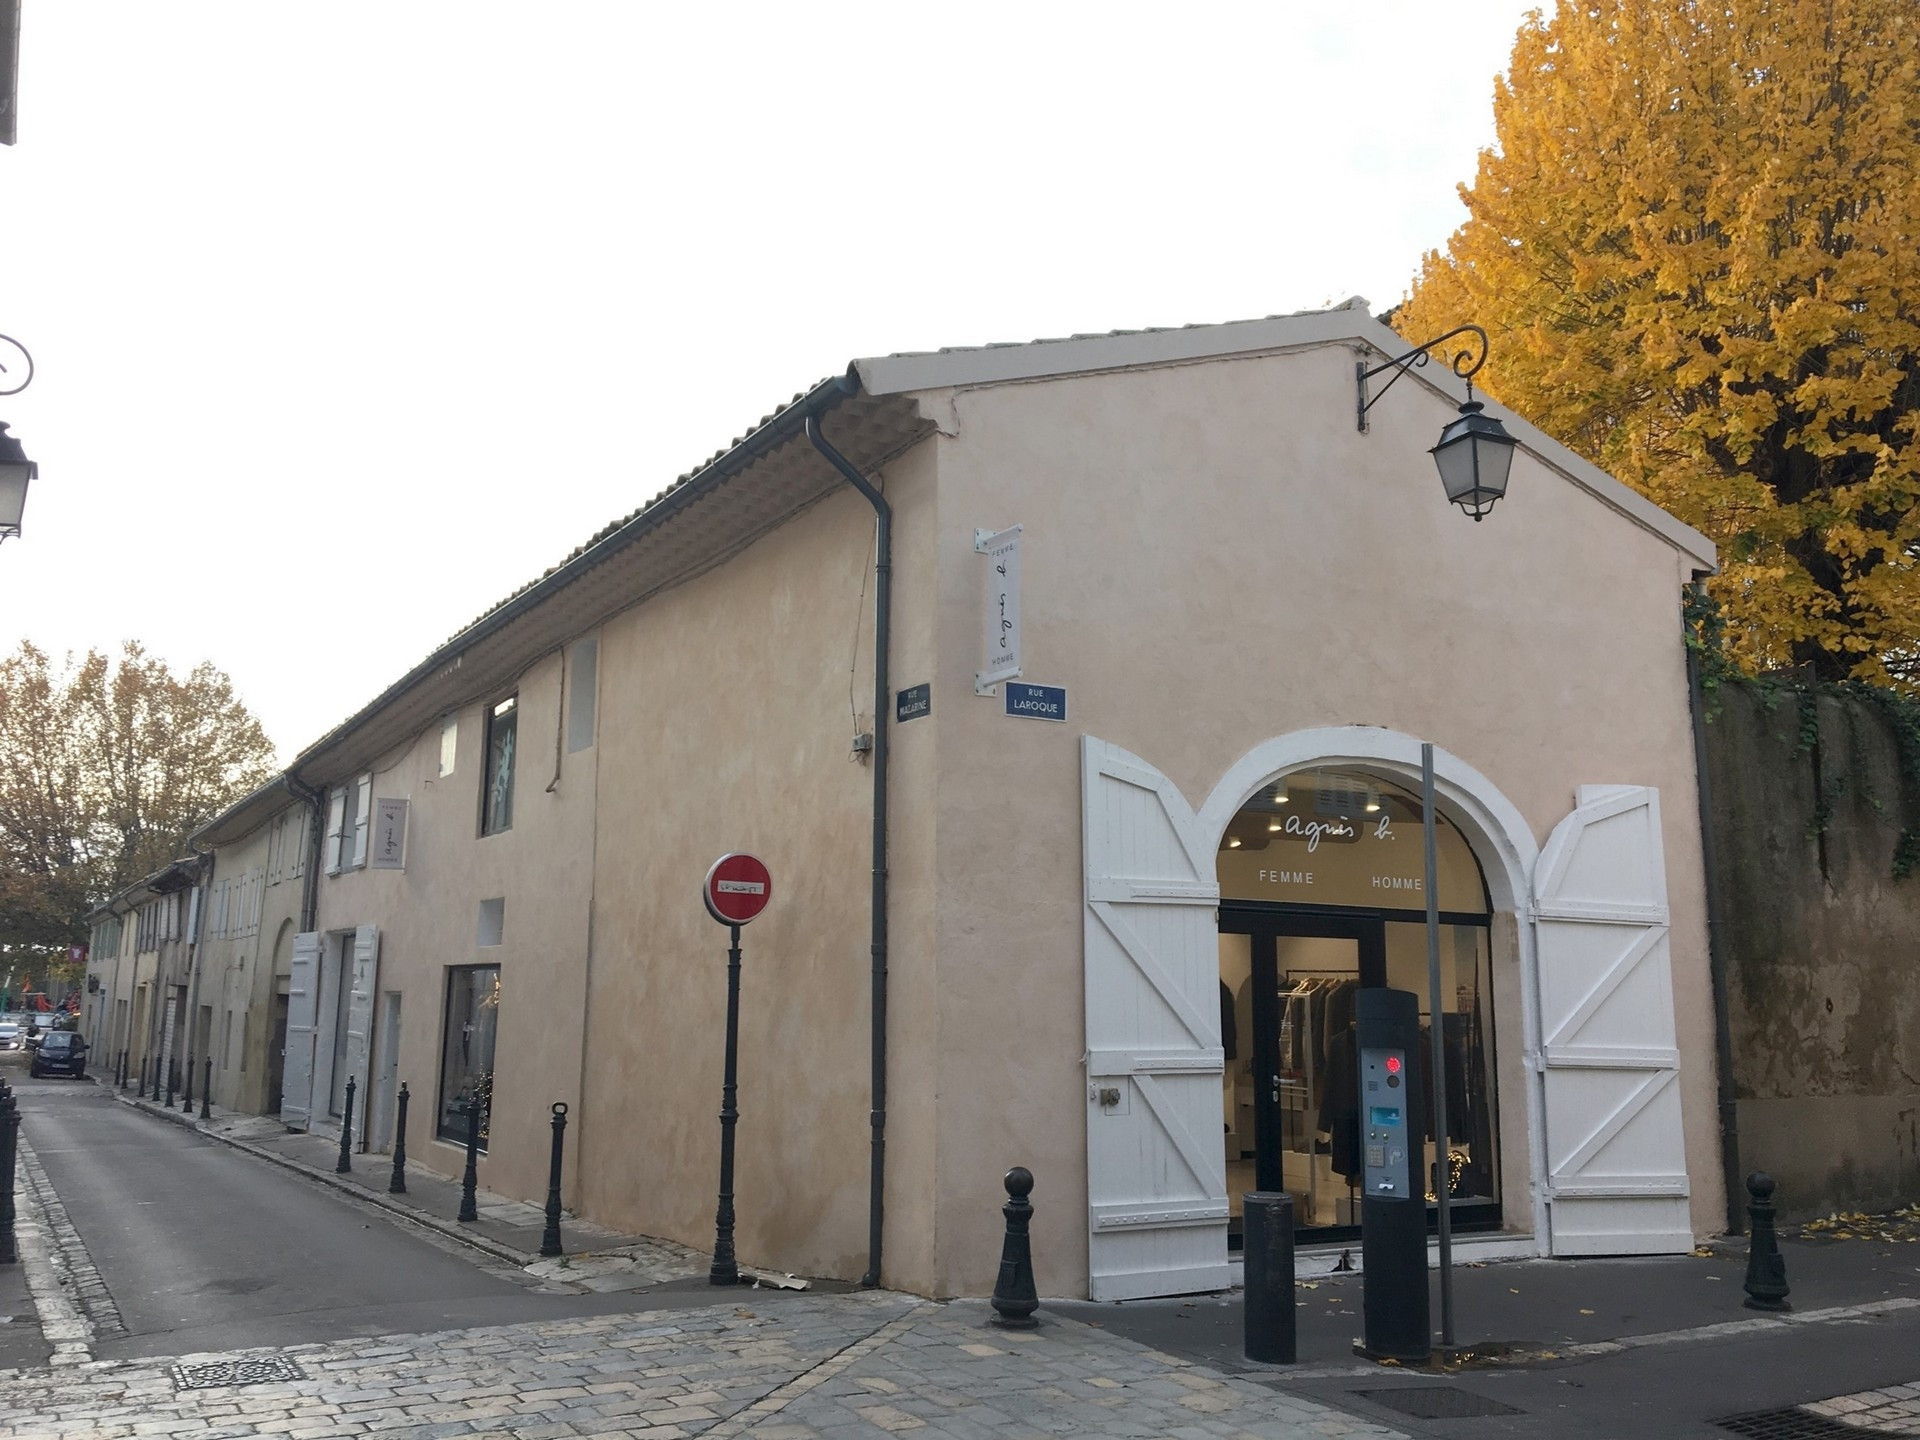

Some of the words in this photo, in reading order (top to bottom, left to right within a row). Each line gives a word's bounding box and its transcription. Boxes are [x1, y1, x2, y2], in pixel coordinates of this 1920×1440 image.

[992, 543, 1014, 558] FEMME
[992, 653, 1014, 665] HOMME
[908, 690, 918, 699] RUE
[1028, 688, 1044, 698] RUE
[1014, 699, 1058, 713] LAROQUE
[1285, 815, 1354, 853] agnès
[1373, 815, 1395, 841] b.
[1259, 869, 1314, 884] FEMME
[1372, 876, 1423, 891] HOMME
